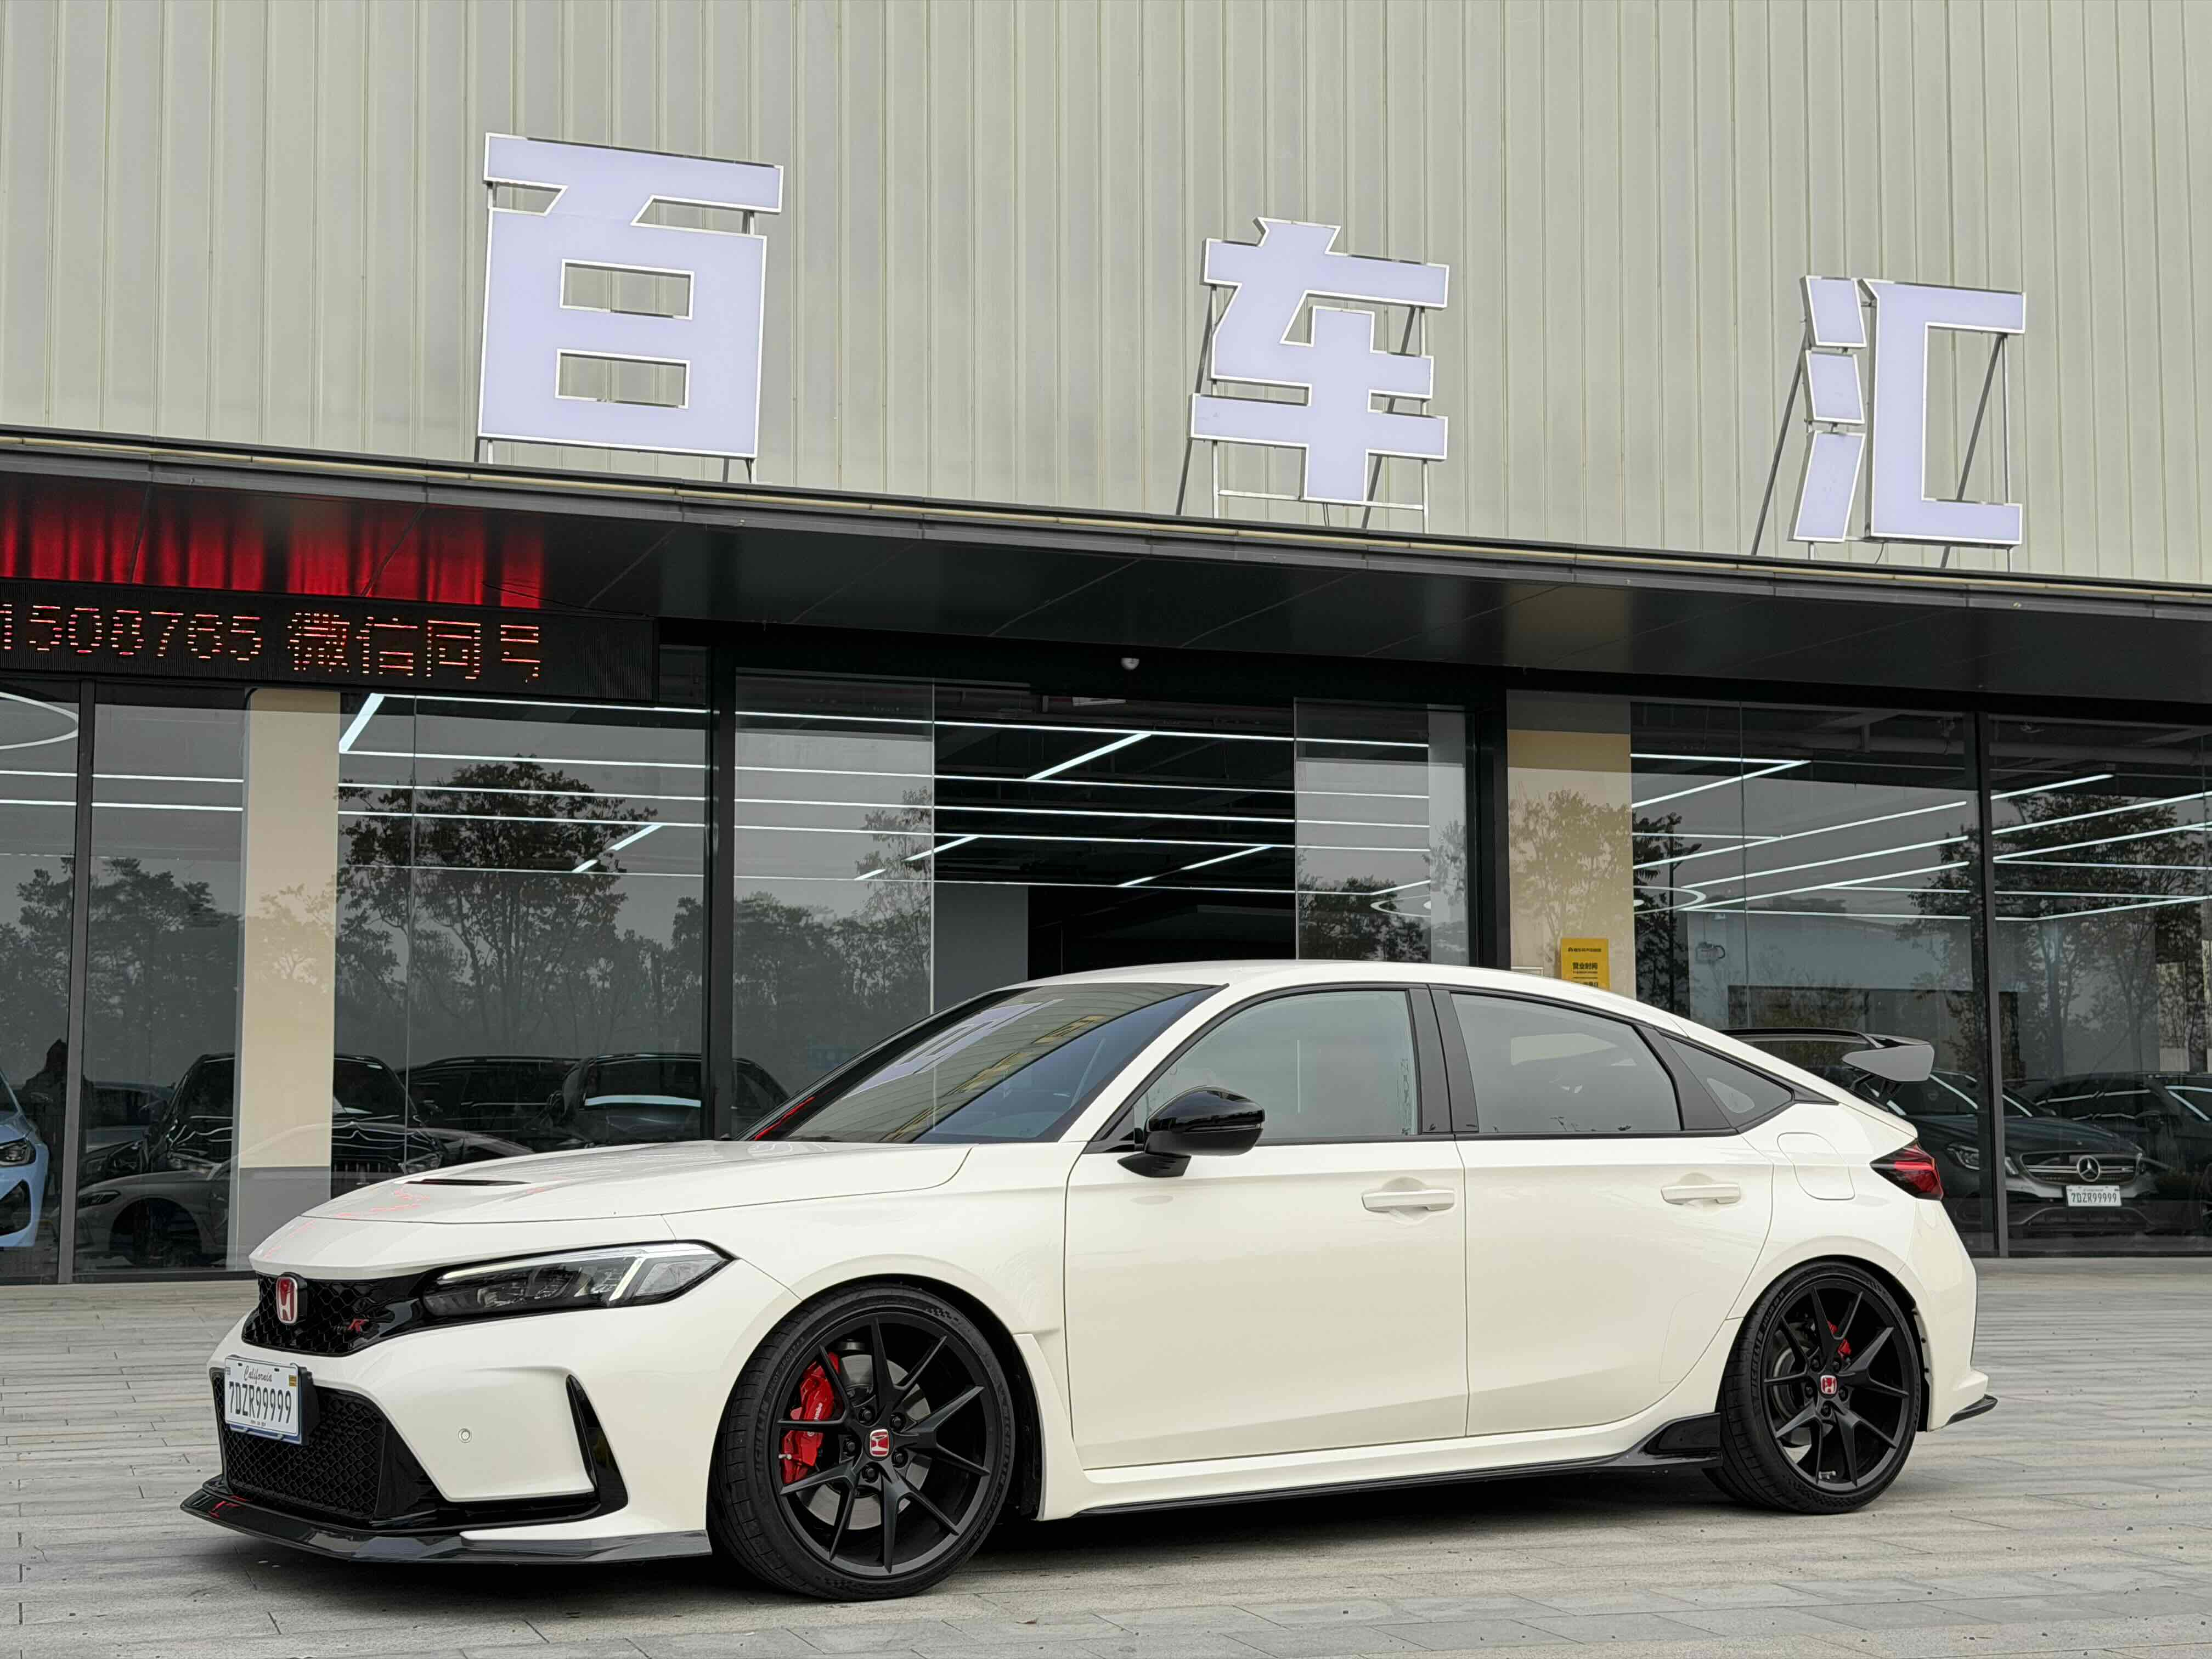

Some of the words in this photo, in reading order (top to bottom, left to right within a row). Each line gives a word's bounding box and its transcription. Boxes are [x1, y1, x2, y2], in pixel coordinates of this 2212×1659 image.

[478, 132, 2026, 545] 百车汇
[286, 612, 540, 682] 微信同号
[2071, 1193, 2117, 1203] 7DZR99999
[244, 1365, 273, 1384] California
[229, 1381, 292, 1424] 7DZR99999
